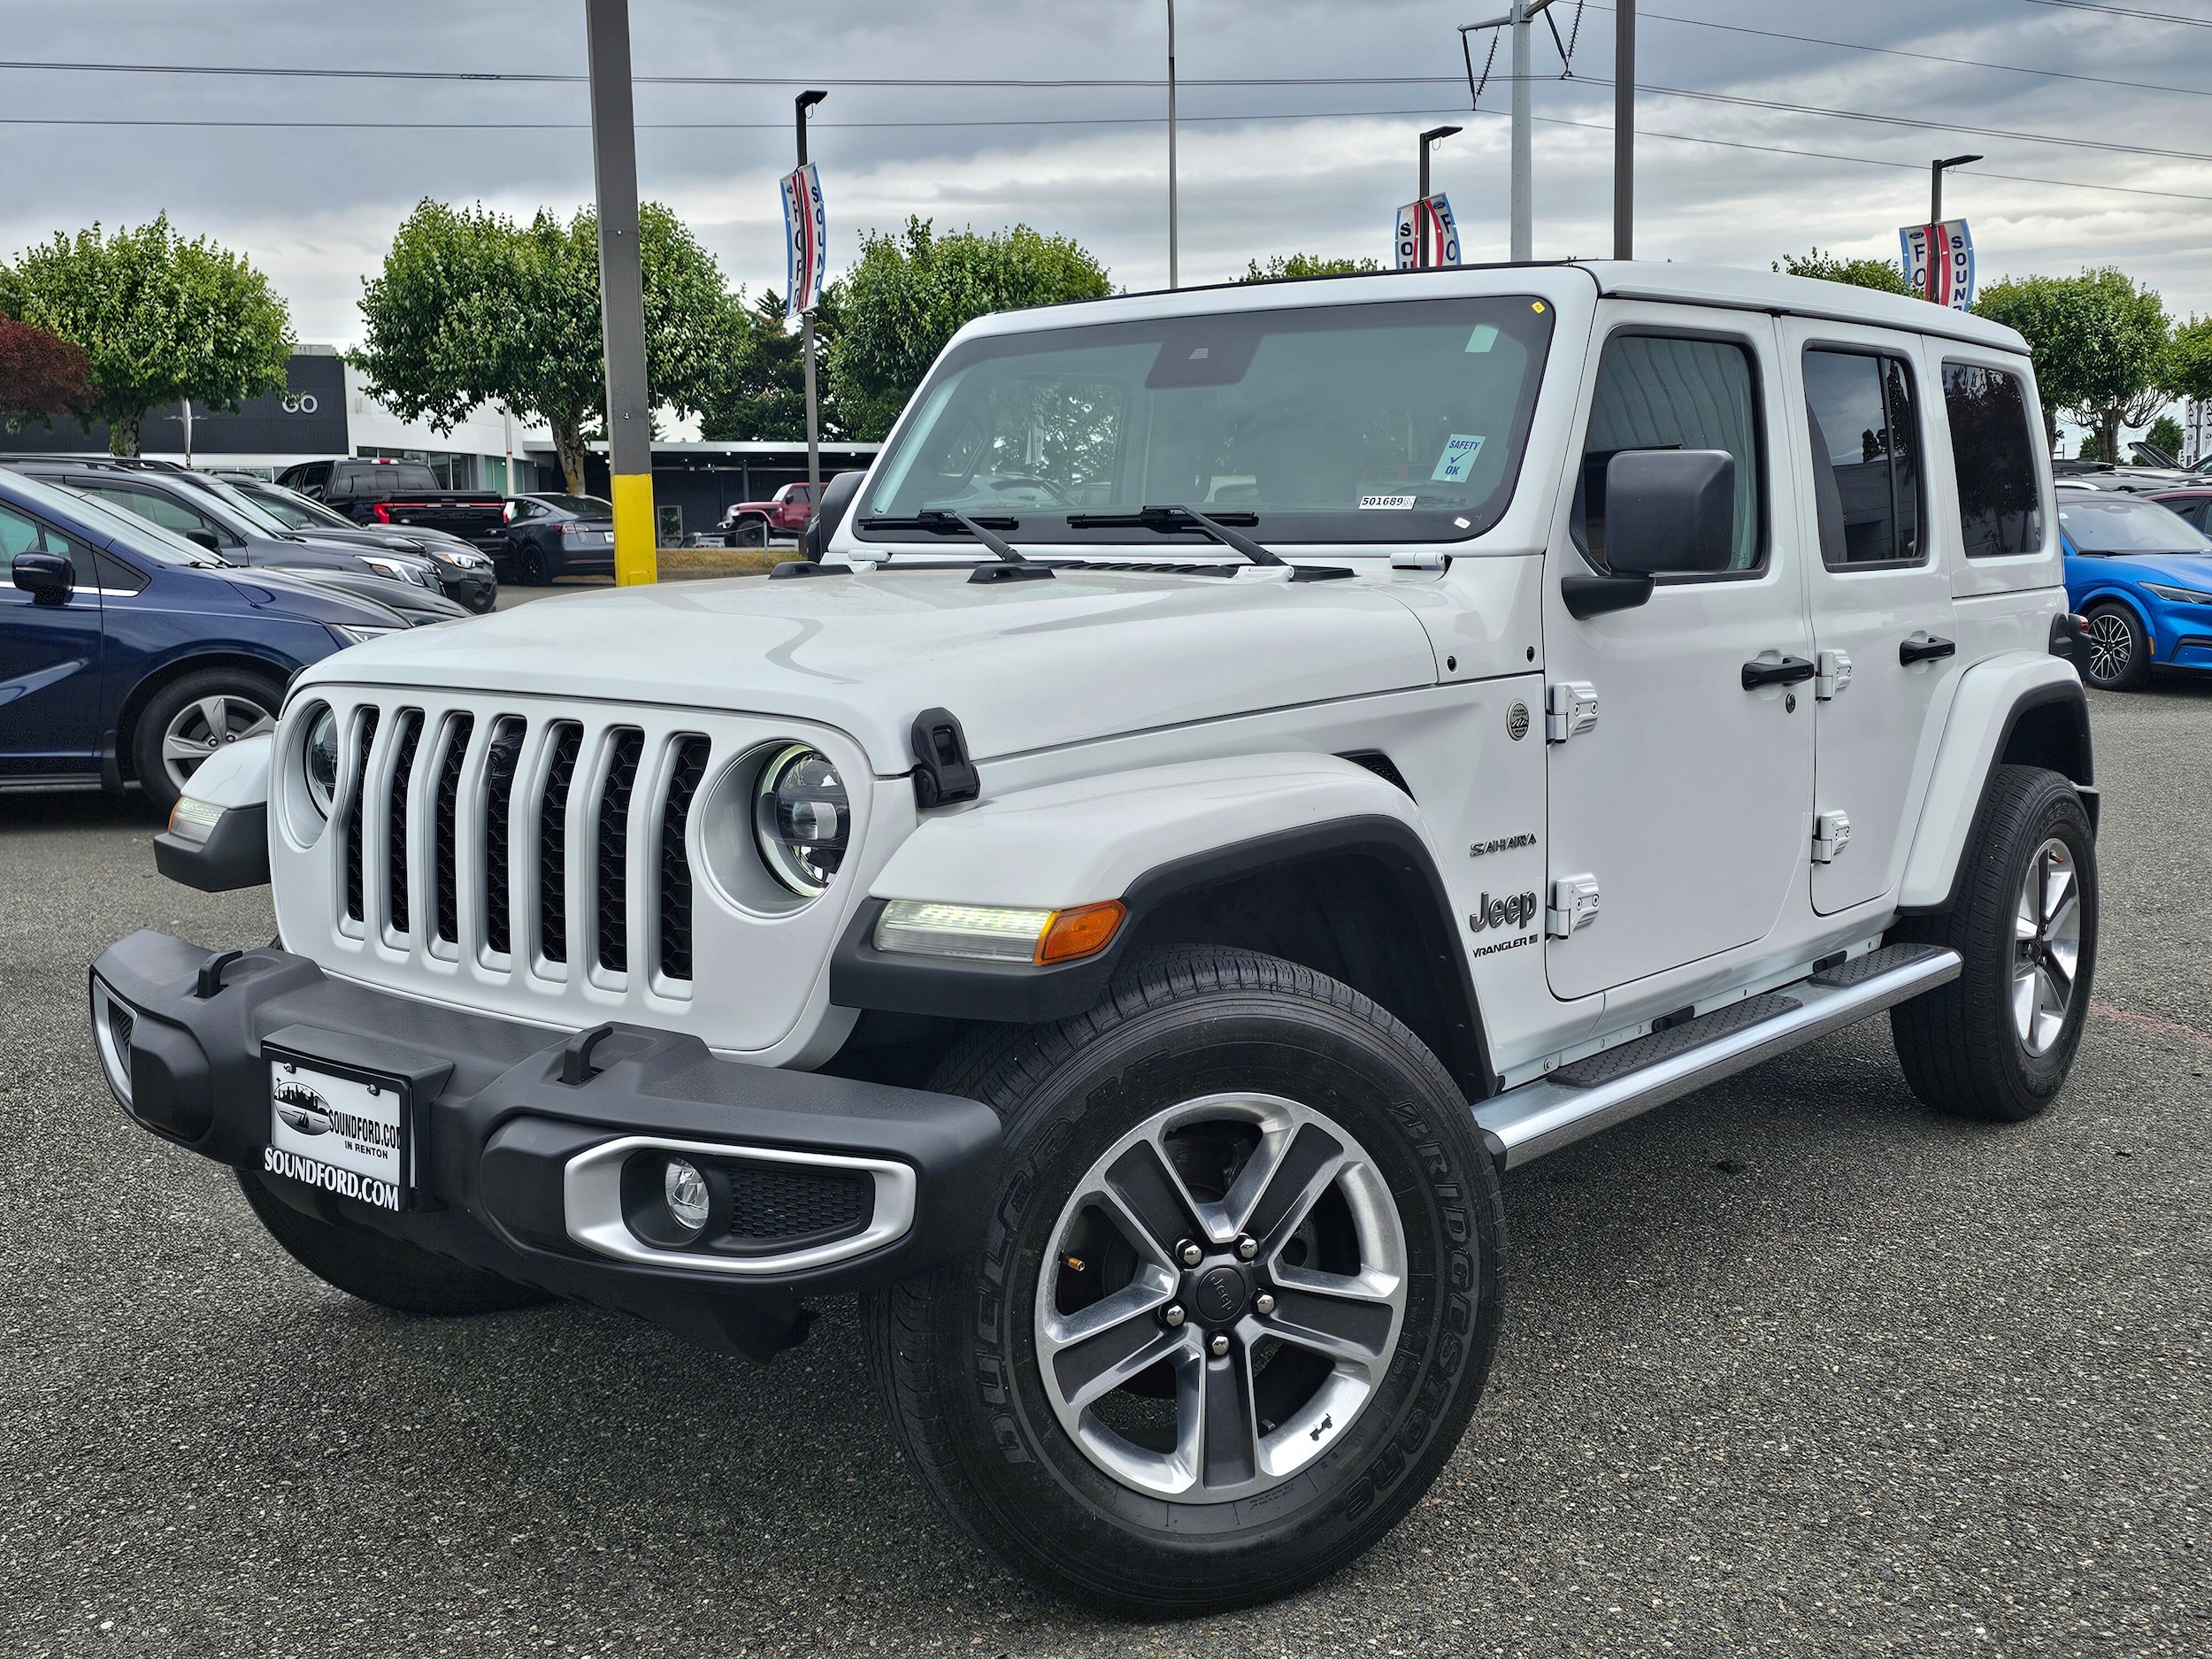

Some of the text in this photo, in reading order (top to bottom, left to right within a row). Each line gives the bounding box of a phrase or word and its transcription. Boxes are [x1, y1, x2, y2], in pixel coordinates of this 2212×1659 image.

[1448, 439, 1480, 450] SAFETY
[1445, 465, 1461, 475] OK
[1470, 832, 1538, 857] SAHARA
[1469, 890, 1538, 933] Jeep
[344, 1140, 388, 1160] IN RENTON
[264, 1146, 399, 1212] SOUNDFORD.COM
[1345, 1099, 1476, 1523] BRIDGESTONE
